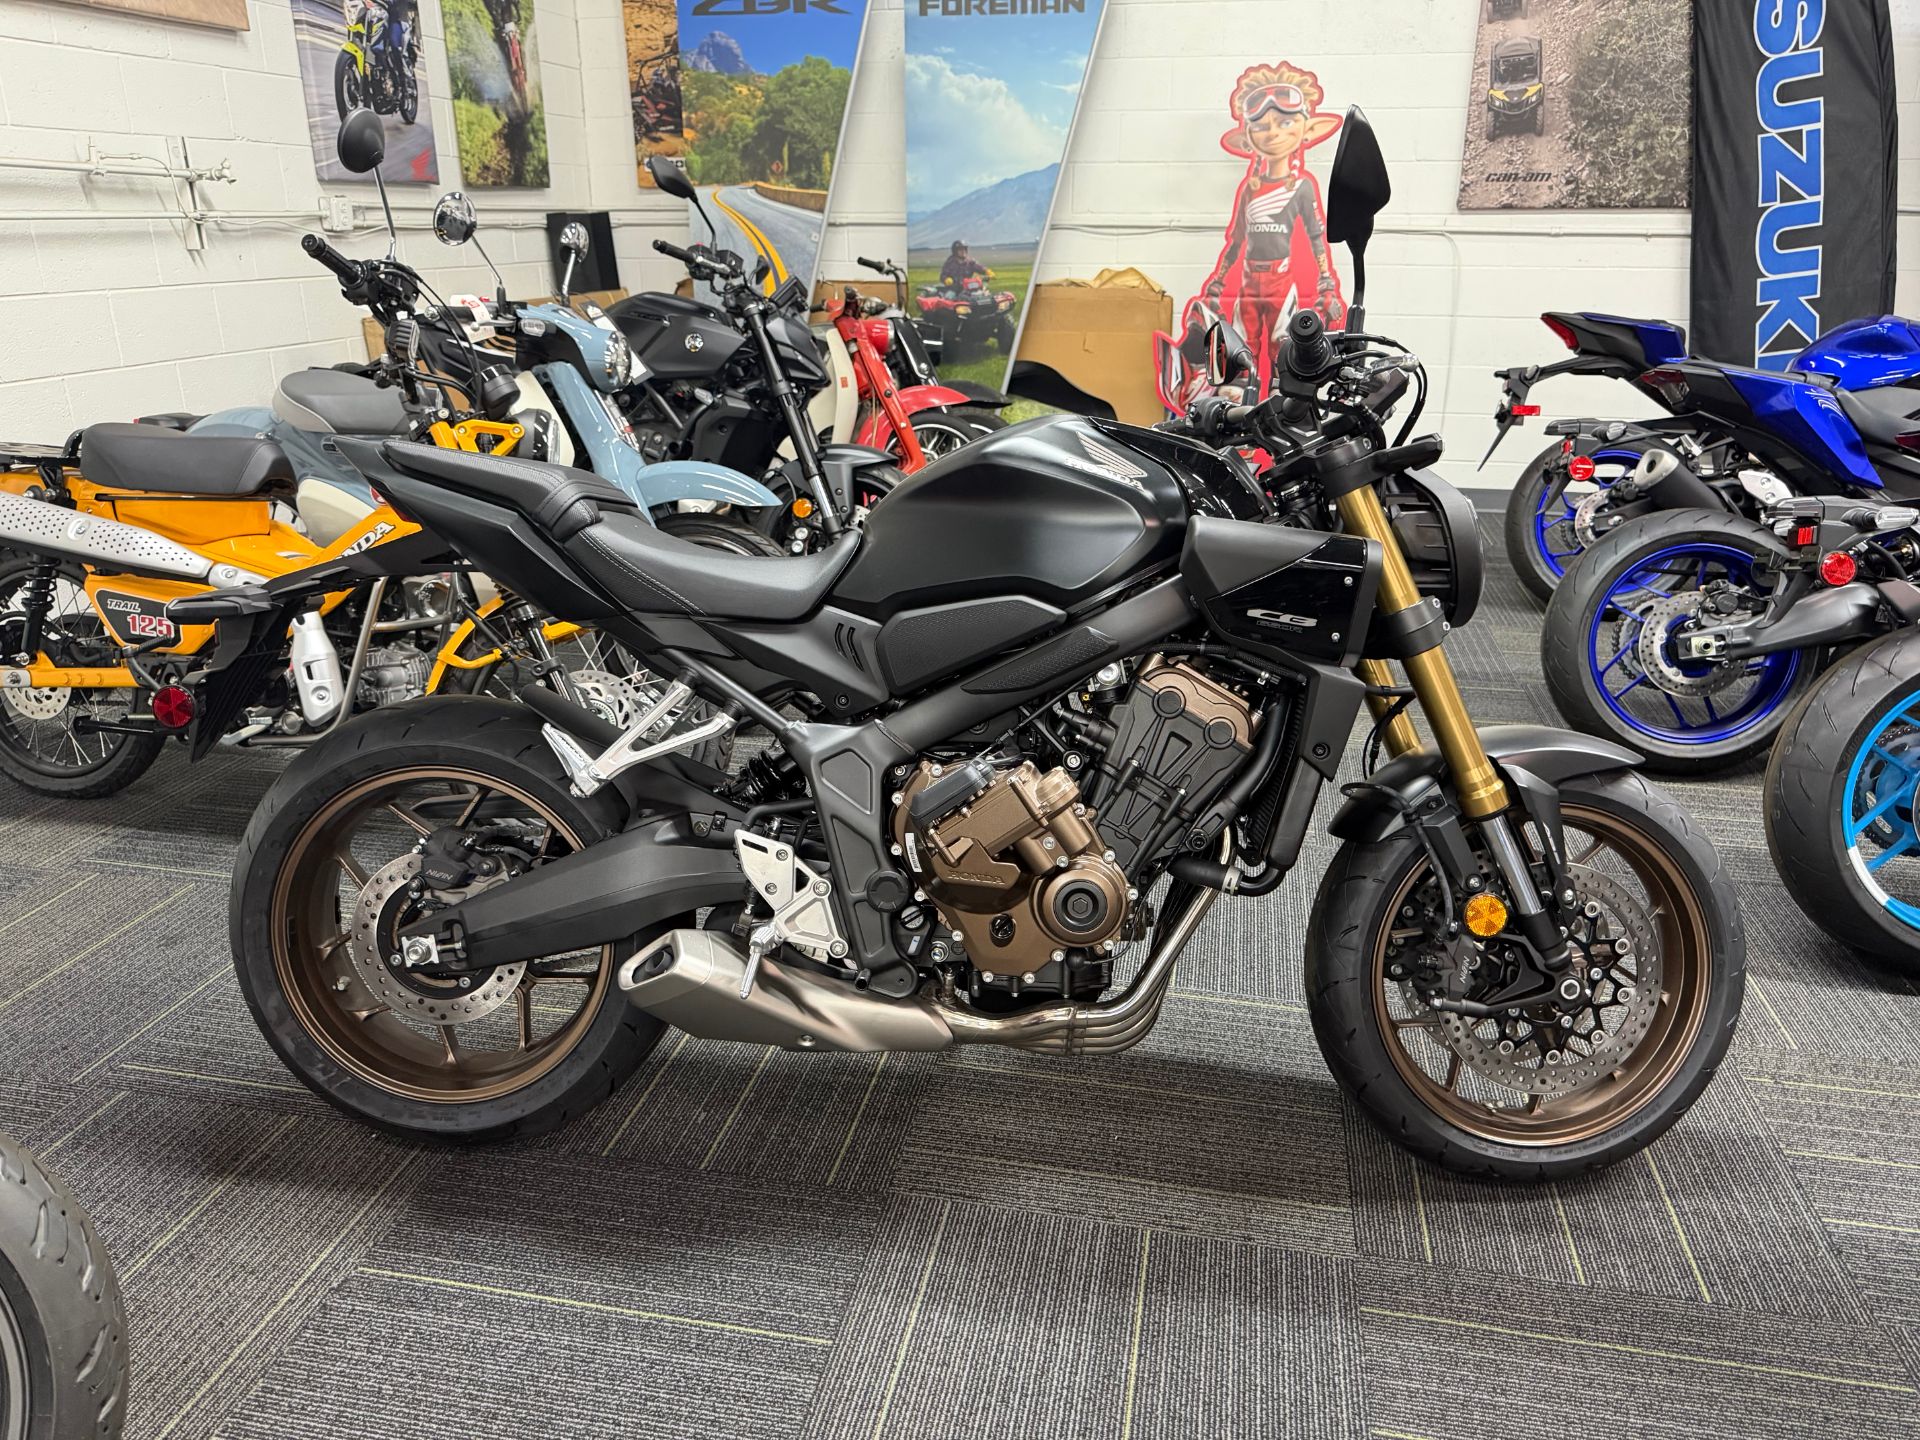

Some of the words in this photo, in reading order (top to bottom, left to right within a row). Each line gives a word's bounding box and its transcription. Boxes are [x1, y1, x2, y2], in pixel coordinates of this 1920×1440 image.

[1247, 223, 1288, 233] HONDA
[107, 598, 142, 613] TRAIL
[126, 613, 175, 639] 125
[1246, 608, 1318, 627] CB
[947, 868, 1006, 885] HONDA
